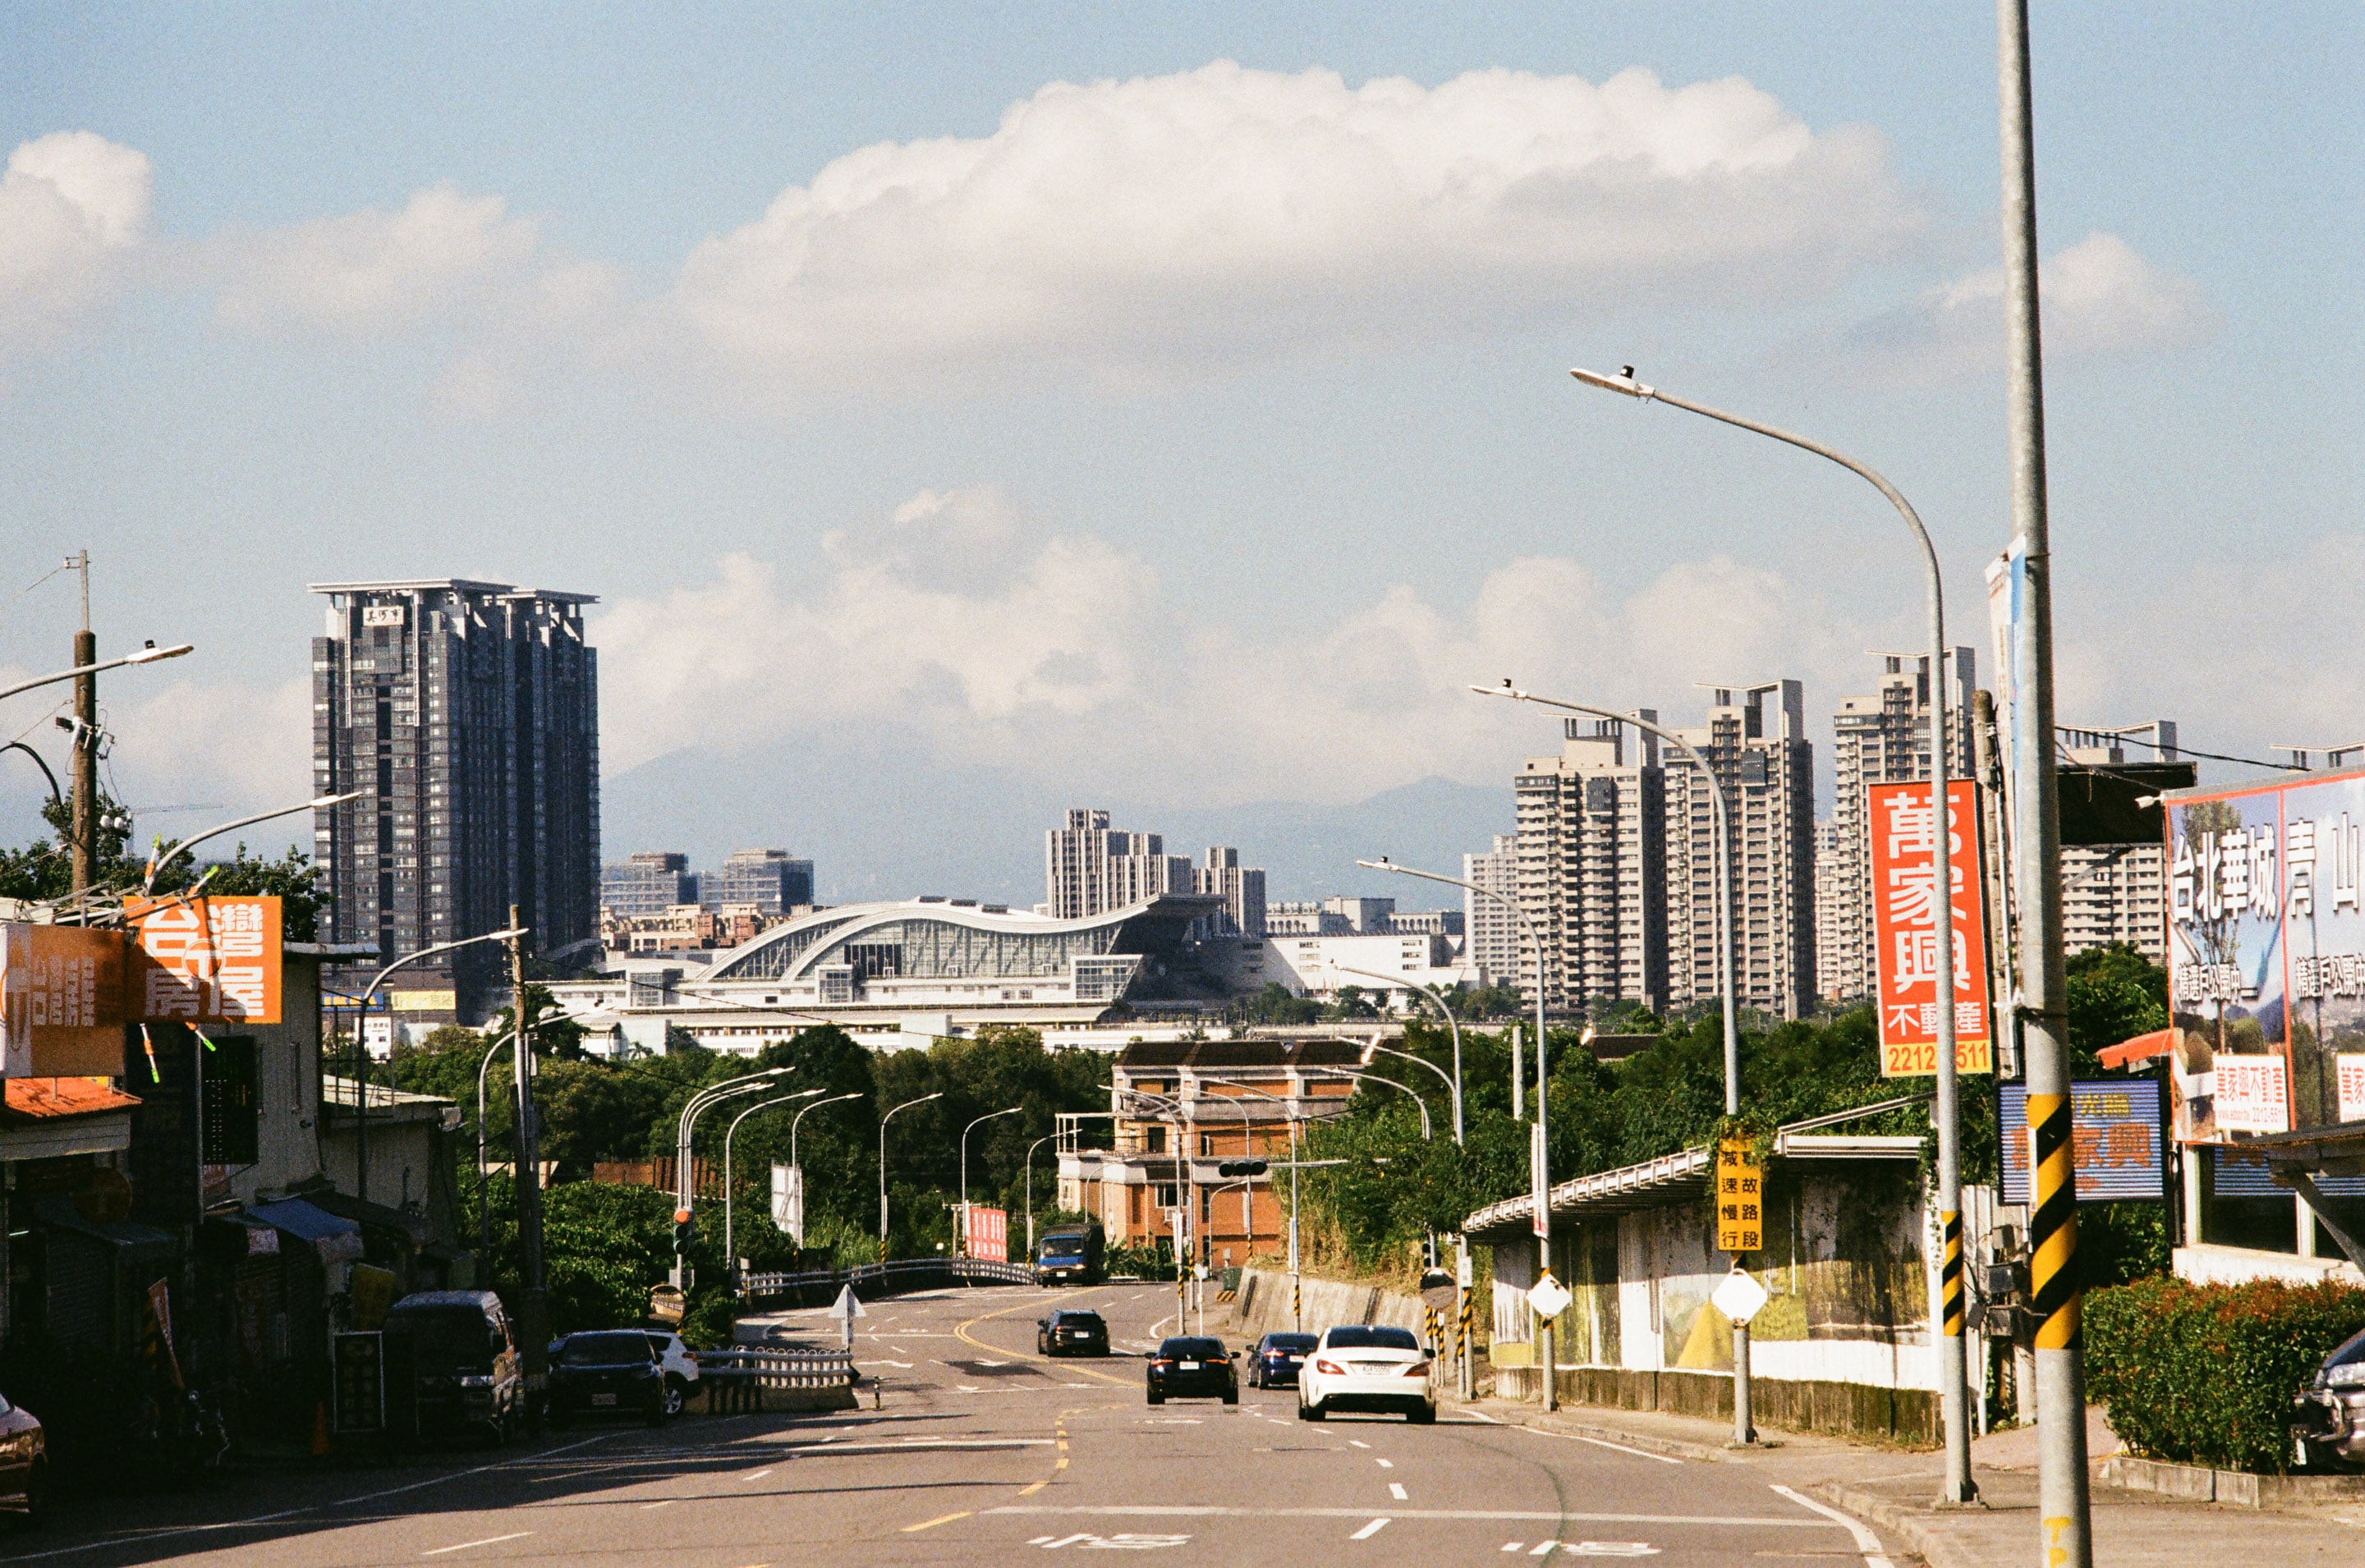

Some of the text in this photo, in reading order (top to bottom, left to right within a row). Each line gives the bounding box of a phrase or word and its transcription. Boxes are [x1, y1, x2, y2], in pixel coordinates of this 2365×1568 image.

[1883, 791, 1972, 996] 萬家興
[2172, 823, 2277, 923] 台北華城
[143, 904, 264, 957] 台灣
[145, 966, 264, 1017] 房屋
[2216, 1066, 2285, 1103] 萬家興不動產
